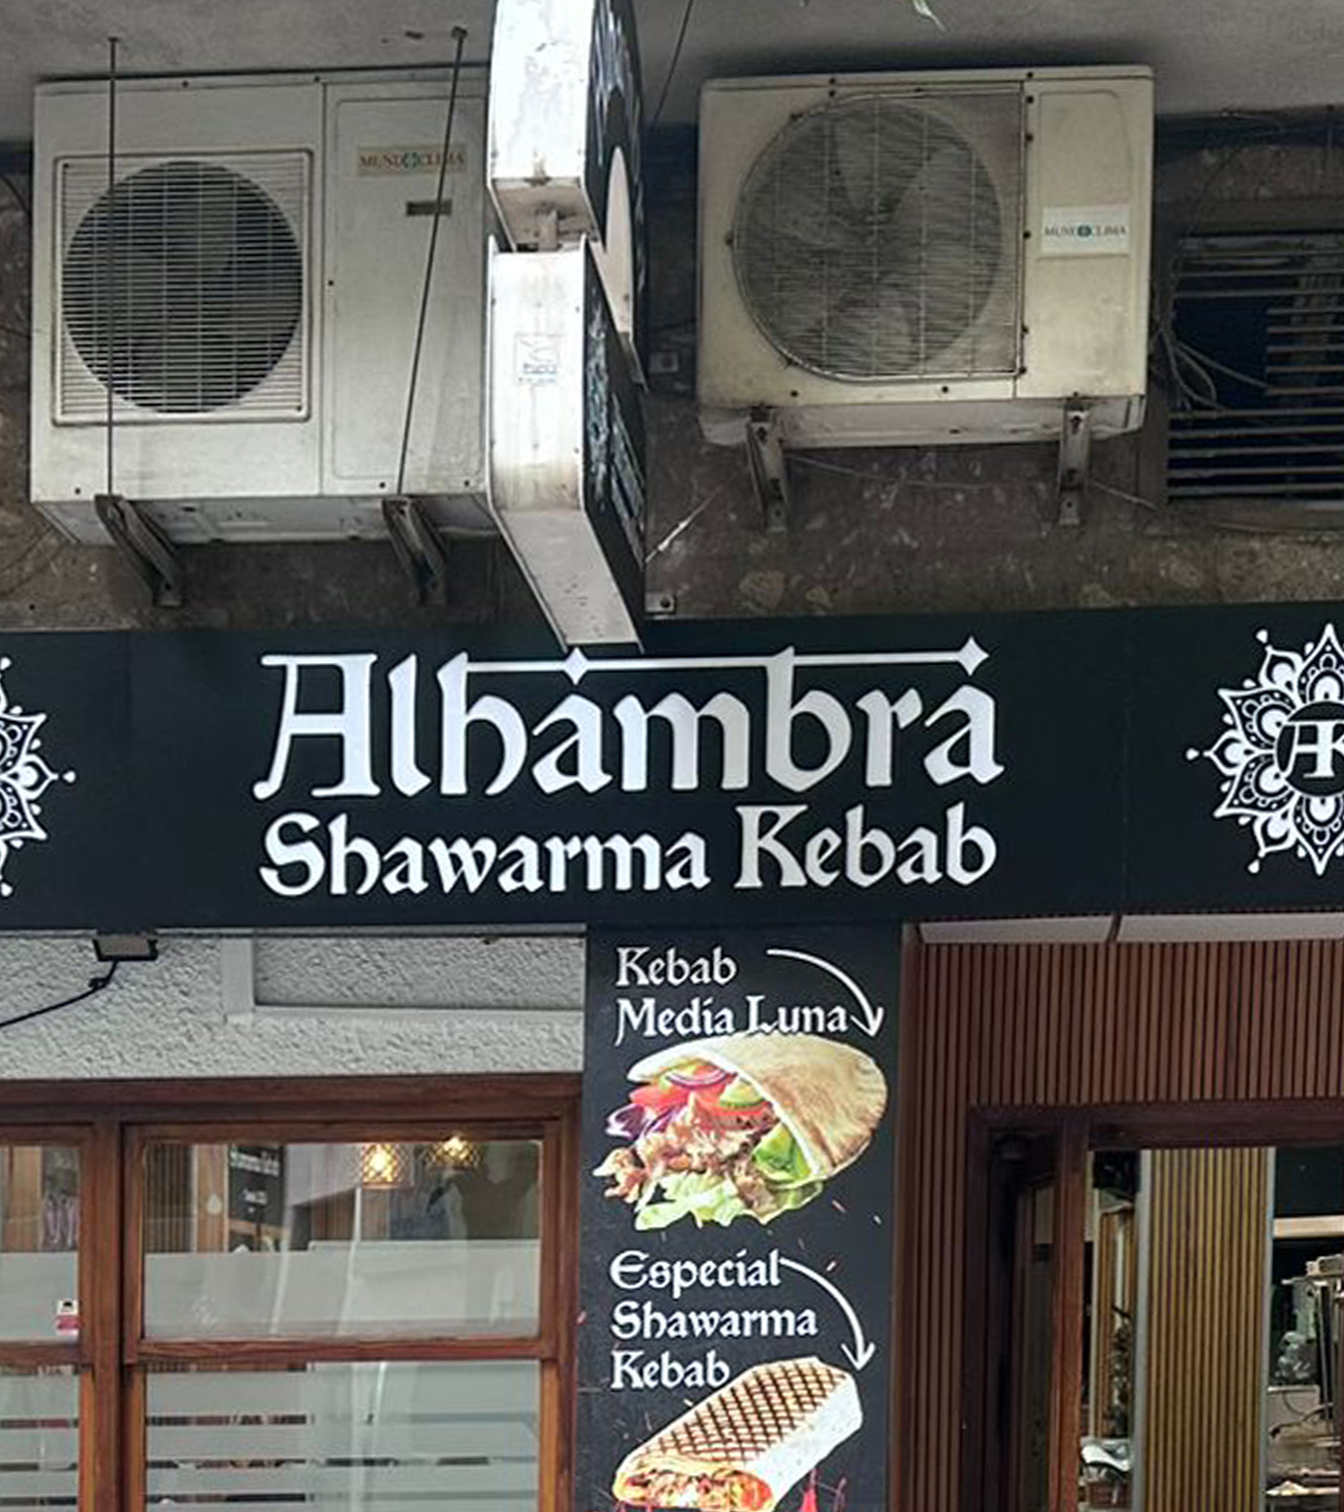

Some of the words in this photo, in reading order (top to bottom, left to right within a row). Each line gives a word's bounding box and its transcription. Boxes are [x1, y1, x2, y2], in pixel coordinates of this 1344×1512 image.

[253, 638, 1005, 799] Alhambra
[259, 812, 711, 896] Shawarma
[734, 803, 998, 889] Kebab
[615, 946, 737, 986] Kebab
[614, 996, 736, 1046] Media
[743, 995, 849, 1033] Luna
[609, 1249, 781, 1299] Especial
[611, 1300, 818, 1340] Shawarma
[610, 1349, 730, 1389] Kebab
